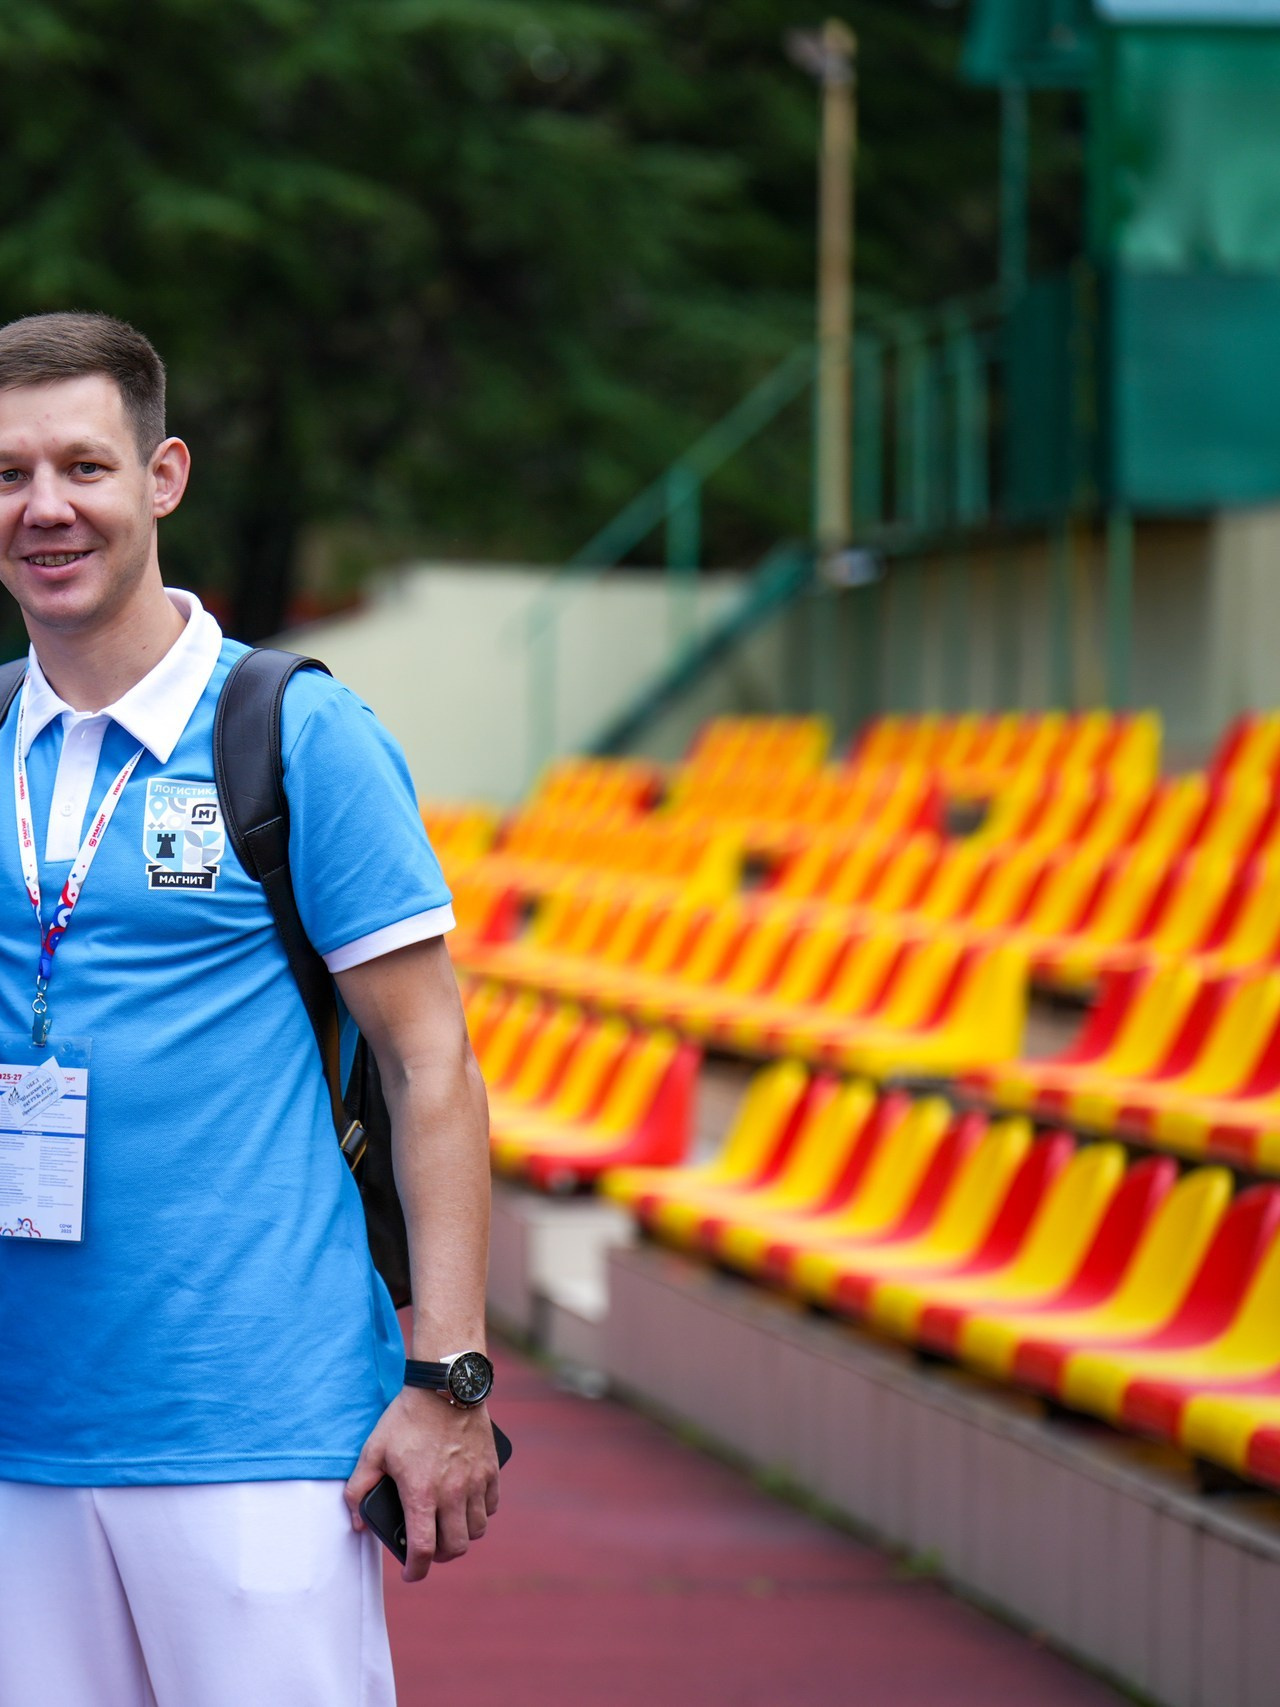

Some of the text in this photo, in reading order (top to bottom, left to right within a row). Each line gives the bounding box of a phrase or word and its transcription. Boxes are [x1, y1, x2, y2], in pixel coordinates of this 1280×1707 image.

[113, 770, 129, 796] ПЕРВАЯ
[92, 813, 106, 838] МАГНИТ
[159, 875, 205, 885] МАГНИТ
[2, 1073, 22, 1081] 25-27
